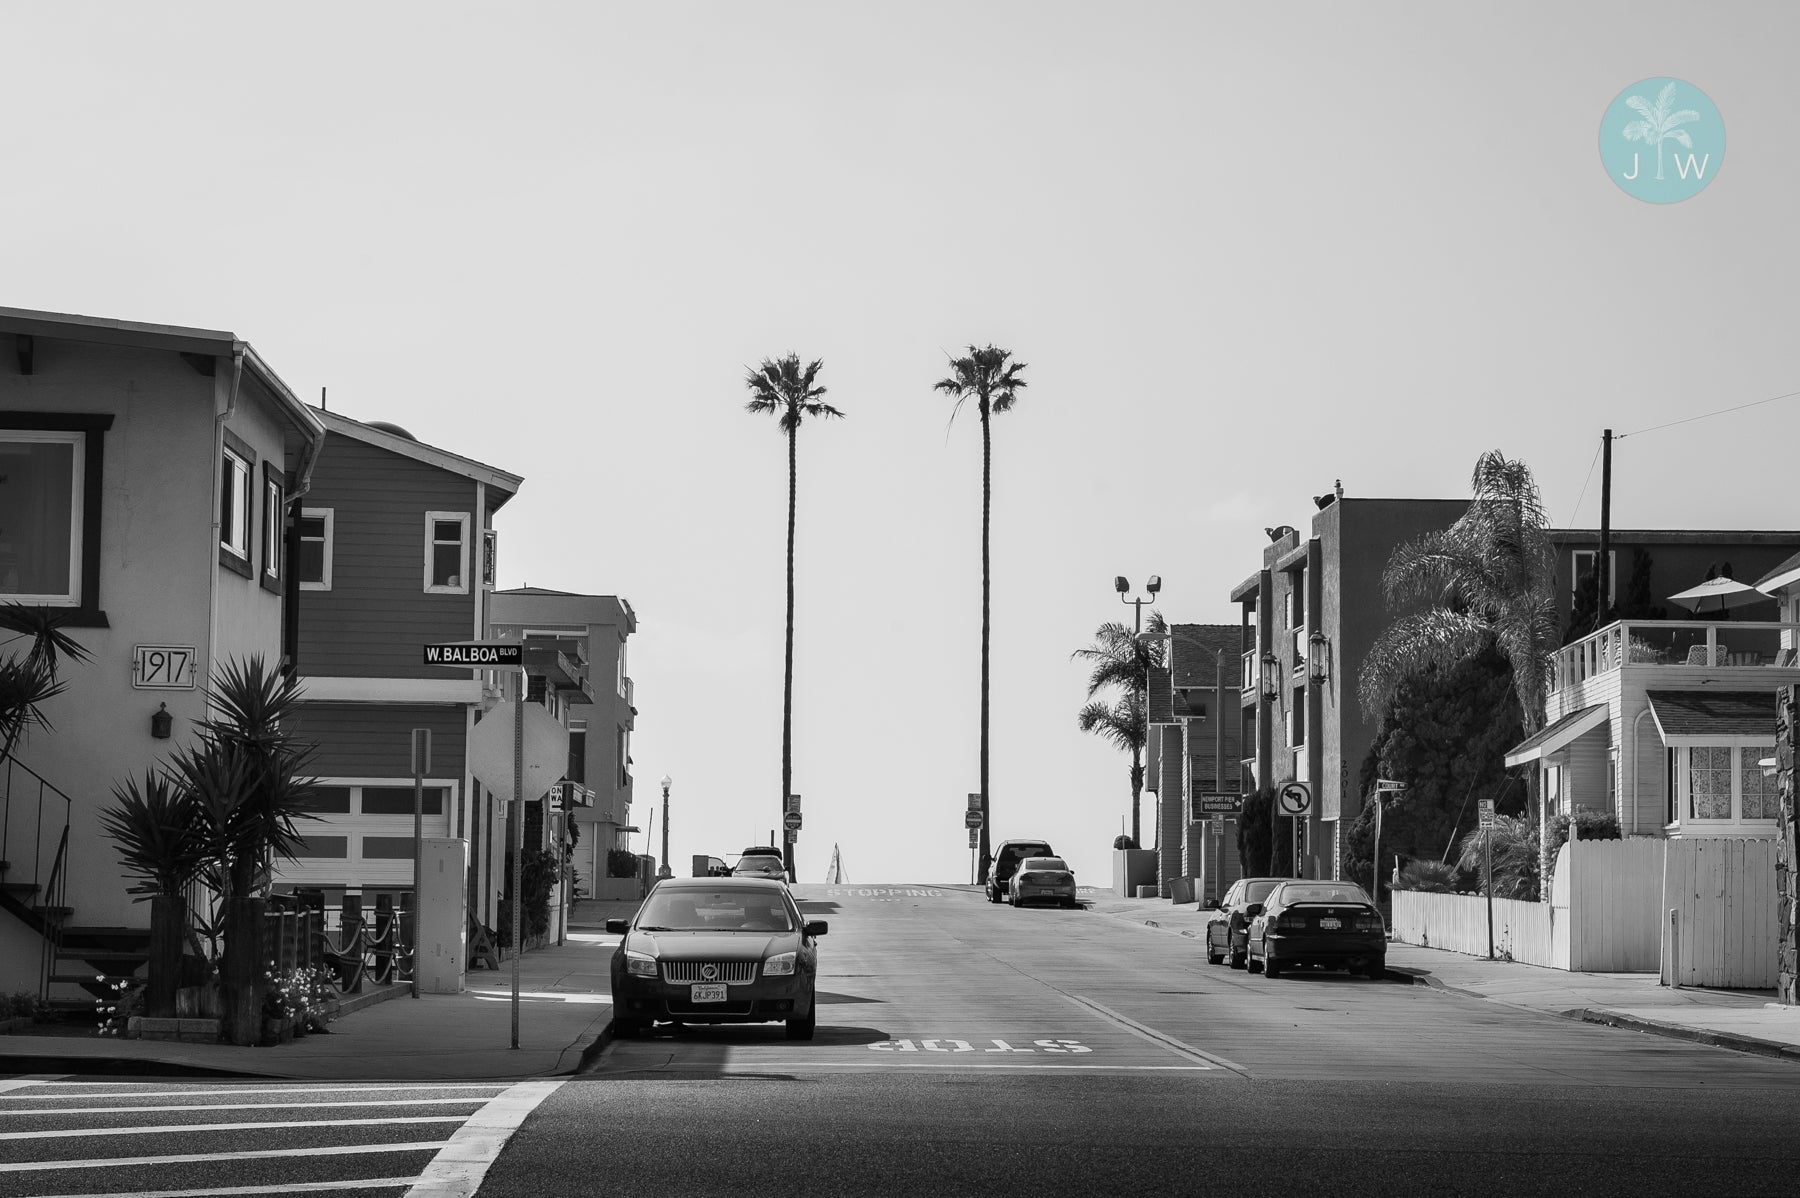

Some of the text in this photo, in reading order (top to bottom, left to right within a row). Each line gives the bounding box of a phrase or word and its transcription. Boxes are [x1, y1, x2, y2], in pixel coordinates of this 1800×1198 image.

[500, 648, 517, 656] BLVD
[142, 651, 187, 682] 1917
[826, 888, 942, 897] STOPPING
[693, 990, 725, 1001] 6KJP391
[867, 1039, 1093, 1053] STOP
